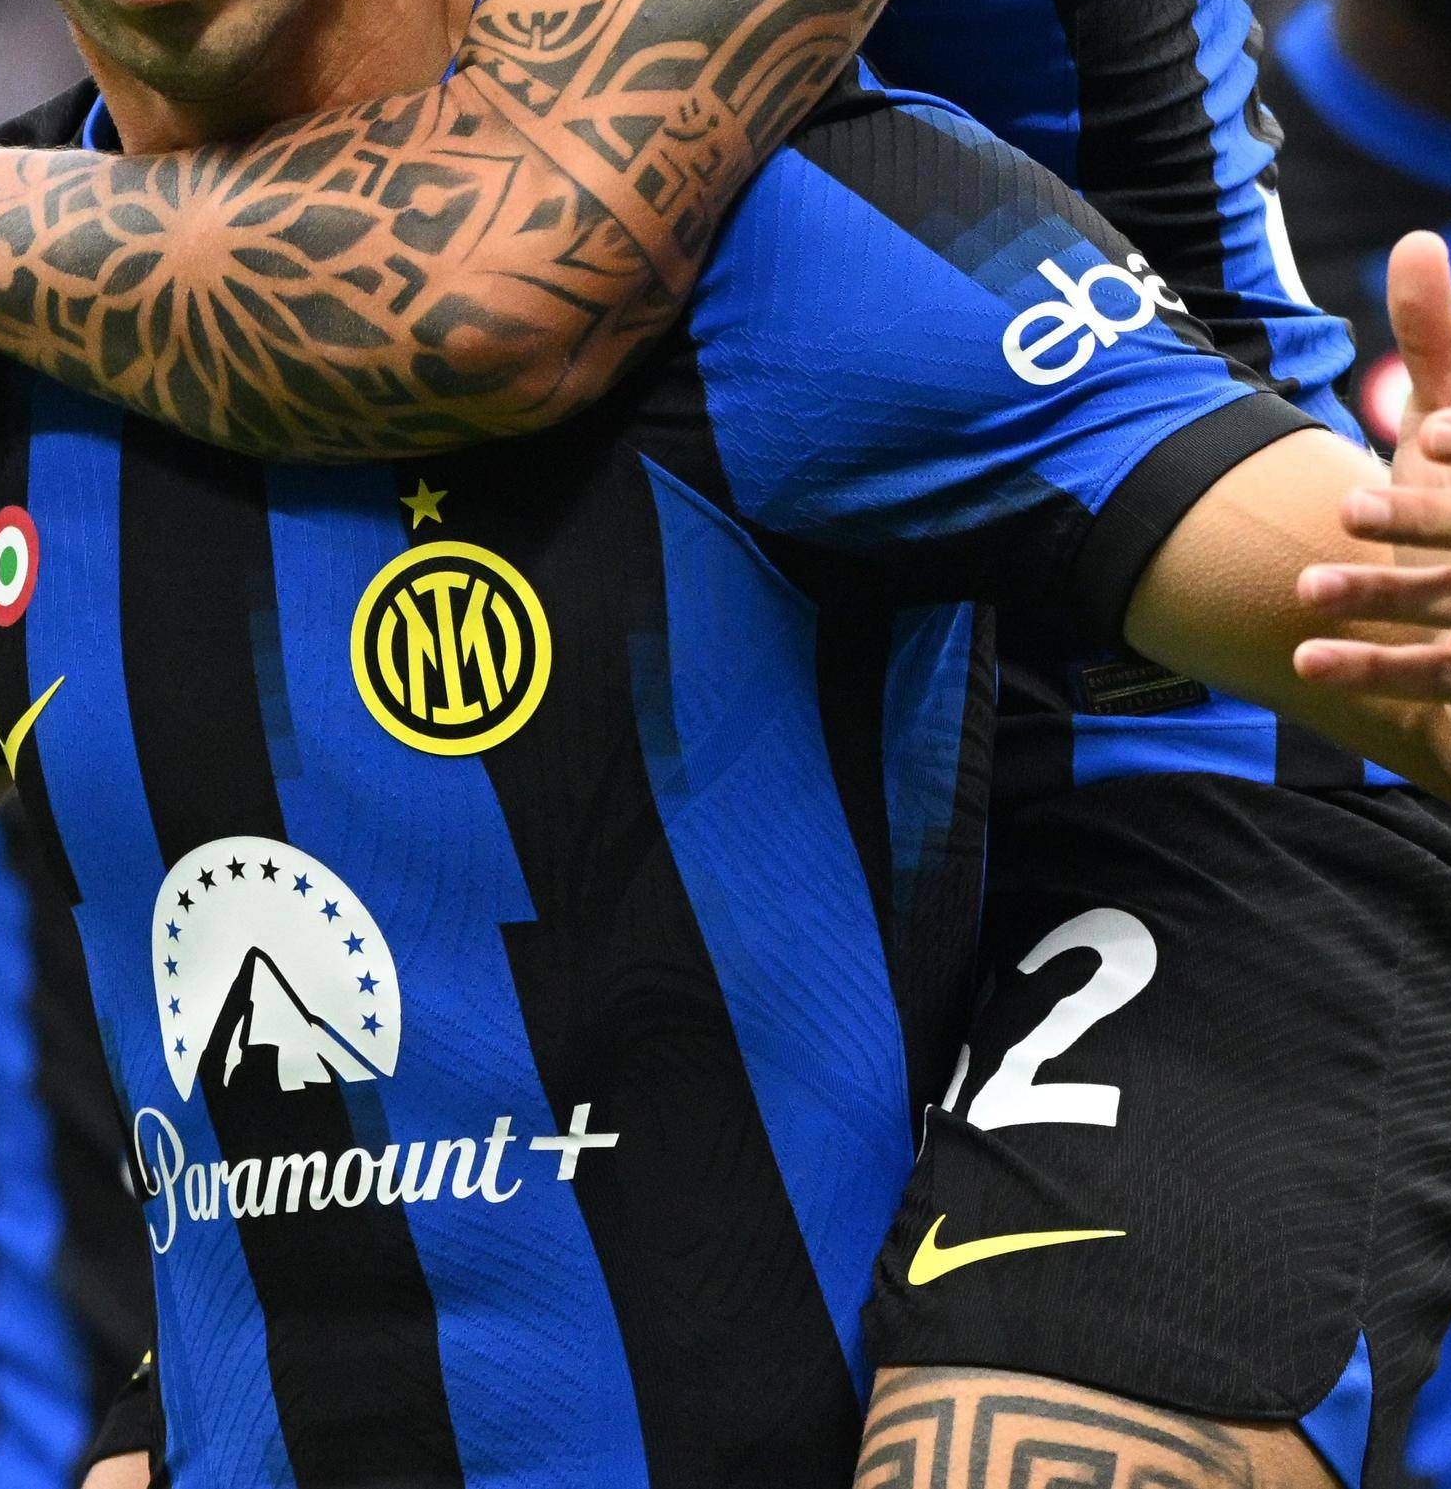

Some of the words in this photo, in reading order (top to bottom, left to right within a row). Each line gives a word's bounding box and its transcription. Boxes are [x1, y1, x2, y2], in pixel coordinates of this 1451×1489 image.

[1002, 252, 1190, 387] eba
[940, 907, 1158, 1132] 2
[124, 1102, 620, 1255] Paramount+
